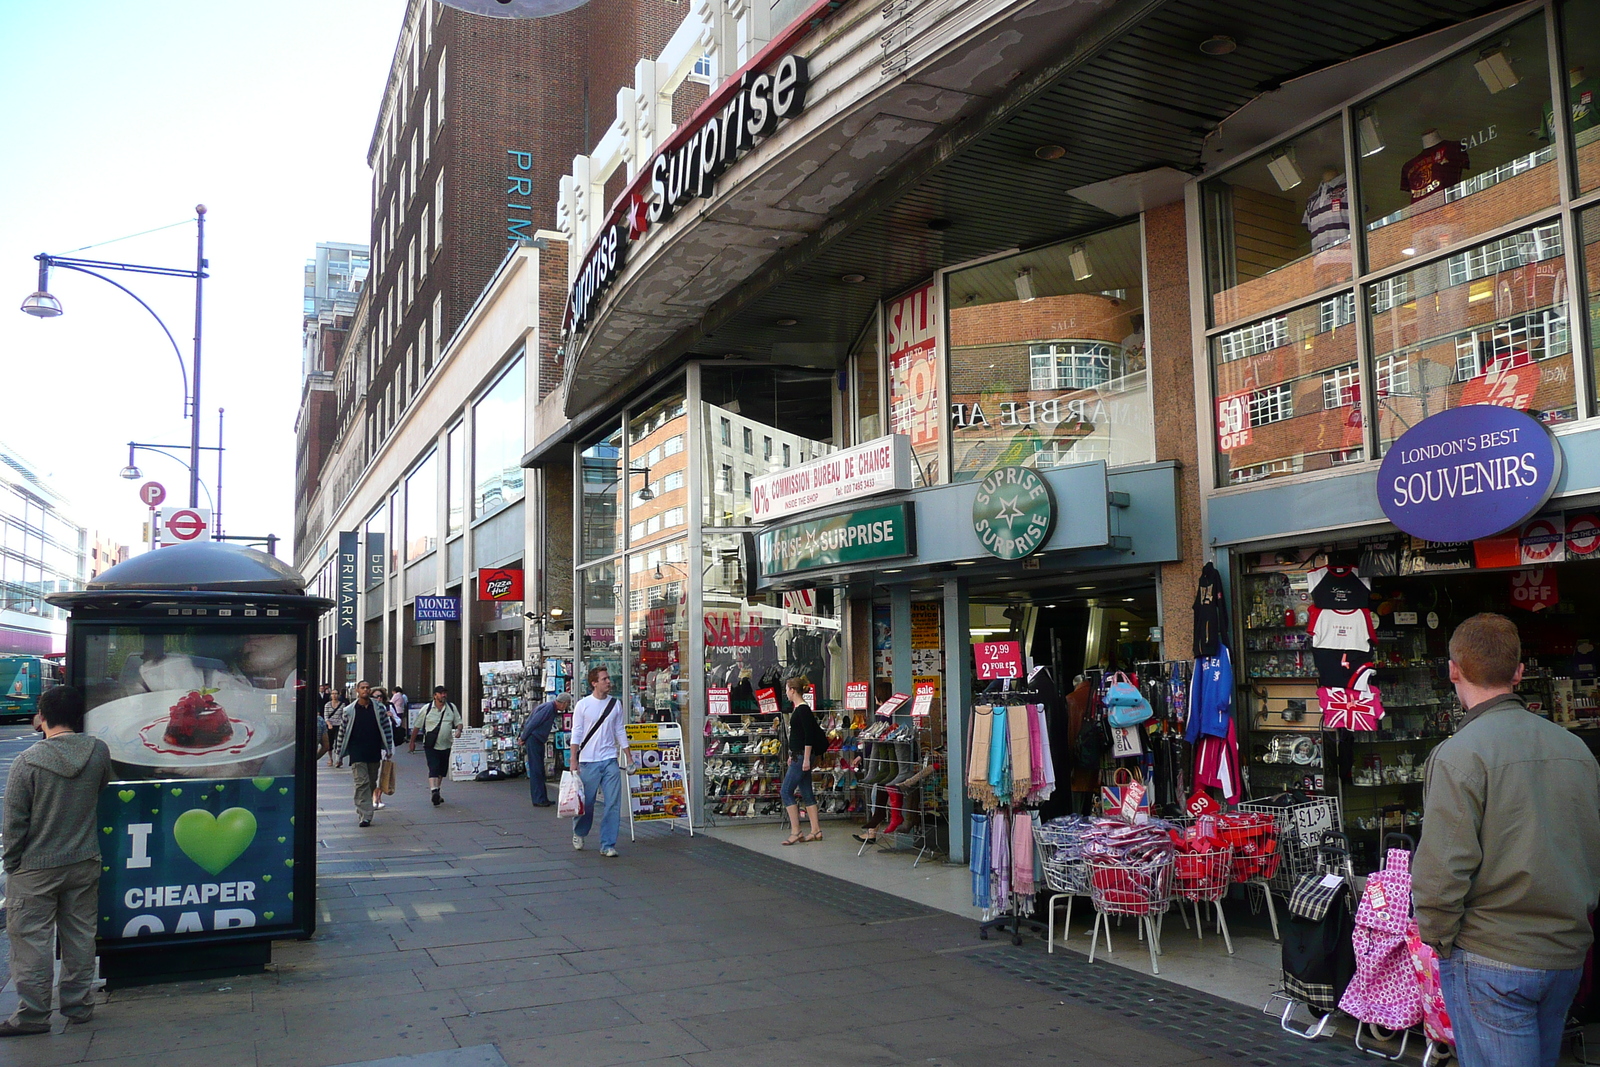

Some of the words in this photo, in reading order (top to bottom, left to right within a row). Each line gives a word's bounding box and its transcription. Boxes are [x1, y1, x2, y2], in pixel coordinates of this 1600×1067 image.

[649, 54, 798, 223] Surprise
[1460, 124, 1498, 153] SALE
[507, 150, 532, 251] PRIM
[570, 224, 618, 334] Surprise
[1051, 318, 1076, 334] SALE
[1219, 394, 1249, 437] 50%
[1220, 431, 1249, 450] OFF
[1401, 433, 1477, 464] LONDON'S
[1481, 427, 1520, 449] BEST
[754, 482, 770, 514] 0%
[771, 472, 810, 500] COMMISSION
[813, 460, 841, 488] BUREAU
[845, 457, 854, 478] DE
[858, 446, 890, 475] CHANGE
[843, 484, 852, 495] 020
[977, 467, 1045, 505] SUPRISE
[1393, 453, 1538, 508] SOUVENIRS
[148, 486, 161, 503] P
[784, 496, 798, 510] INSIDE
[797, 495, 807, 506] THE
[806, 493, 819, 504] SHOP
[820, 519, 894, 552] SURPRISE
[975, 513, 1047, 556] SURPRISE
[341, 553, 355, 628] PRIMARK
[487, 580, 513, 593] Pizza
[491, 586, 508, 597] Hut
[1513, 585, 1552, 601] OFF
[418, 598, 457, 609] MONEY
[418, 609, 457, 618] EXCHANGE
[911, 602, 937, 611] hoto
[704, 611, 763, 647] SALE
[716, 646, 737, 654] NOW
[739, 646, 751, 654] ON
[984, 644, 1010, 660] £2.99
[981, 662, 991, 677] 2
[1005, 661, 1017, 676] £5
[847, 683, 867, 692] sale
[916, 685, 934, 695] sale
[1299, 806, 1326, 828] £1.99
[126, 822, 153, 870] I
[124, 881, 256, 910] CHEAPER
